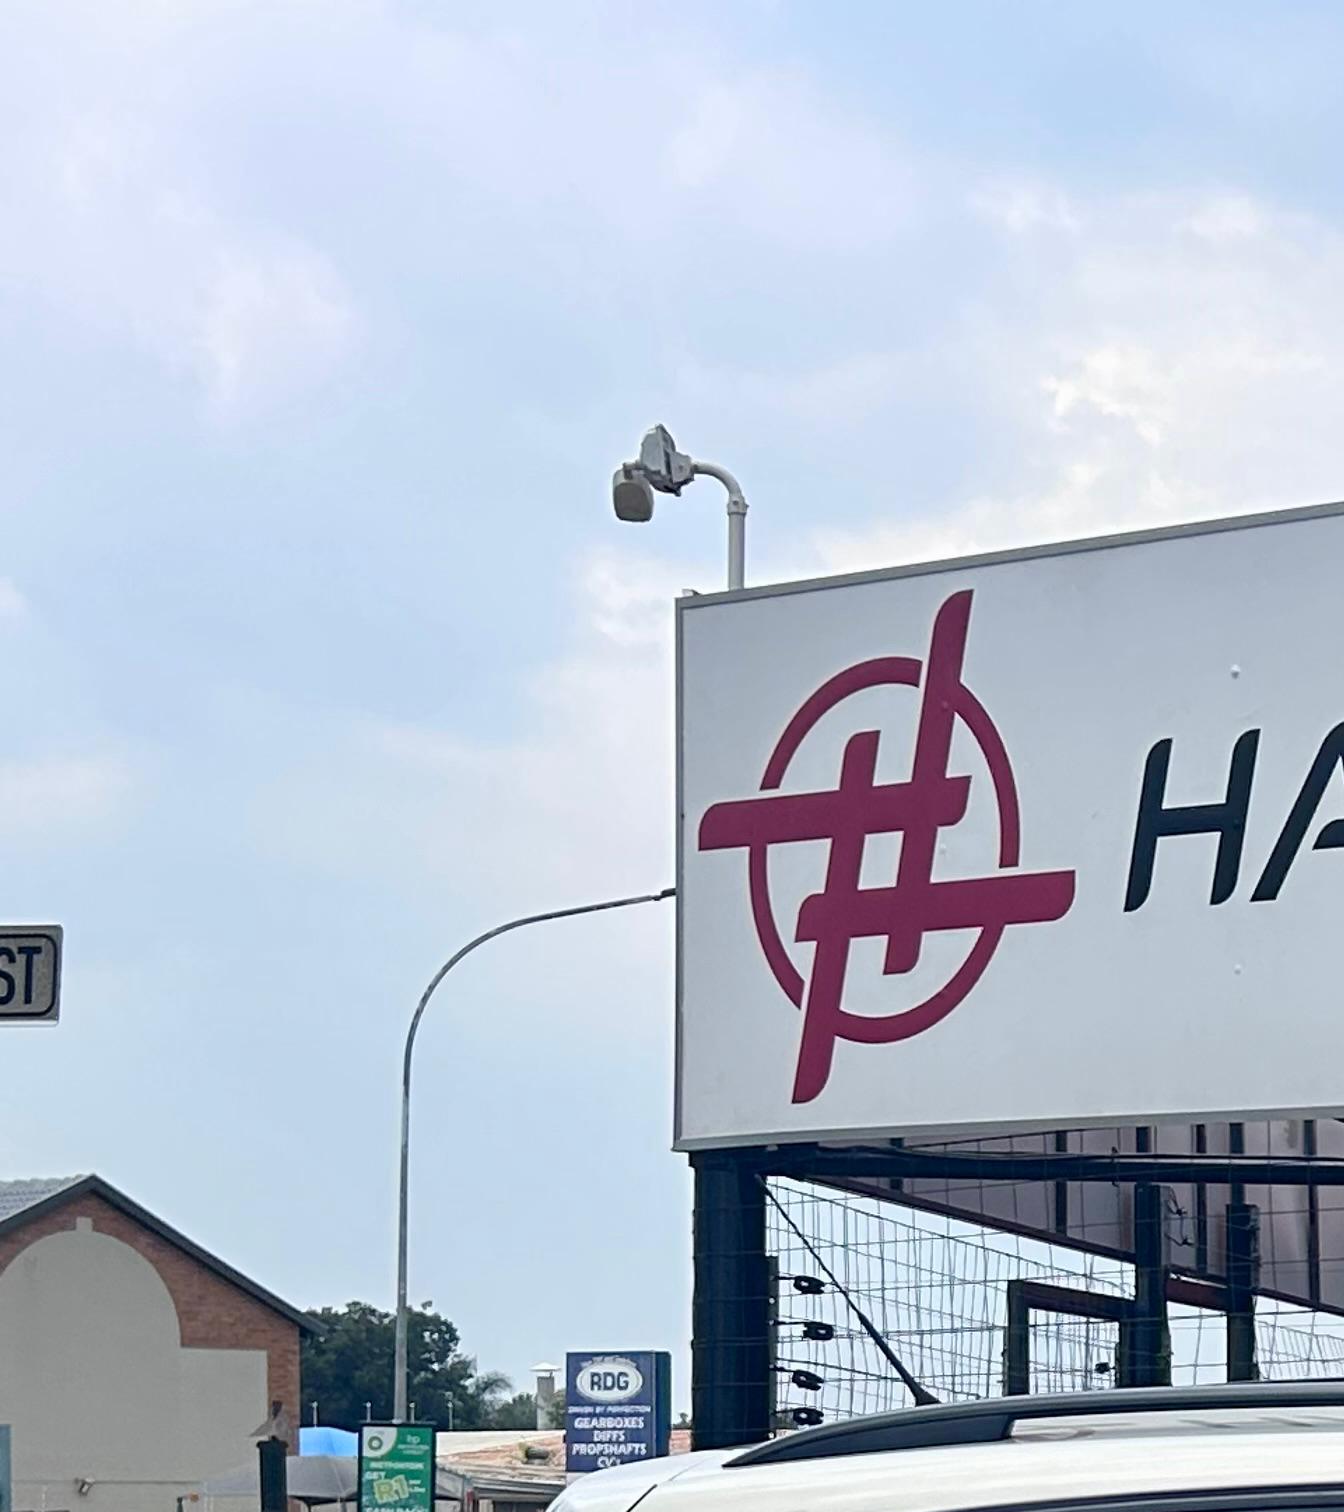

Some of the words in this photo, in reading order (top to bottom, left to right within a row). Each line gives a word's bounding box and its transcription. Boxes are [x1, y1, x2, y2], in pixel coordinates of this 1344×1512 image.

[590, 1372, 629, 1391] RDG
[574, 1417, 645, 1429] GEARBOXES
[593, 1430, 625, 1442] DIFFS
[571, 1443, 647, 1455] PROPSHAFTS
[373, 1474, 410, 1505] R1
